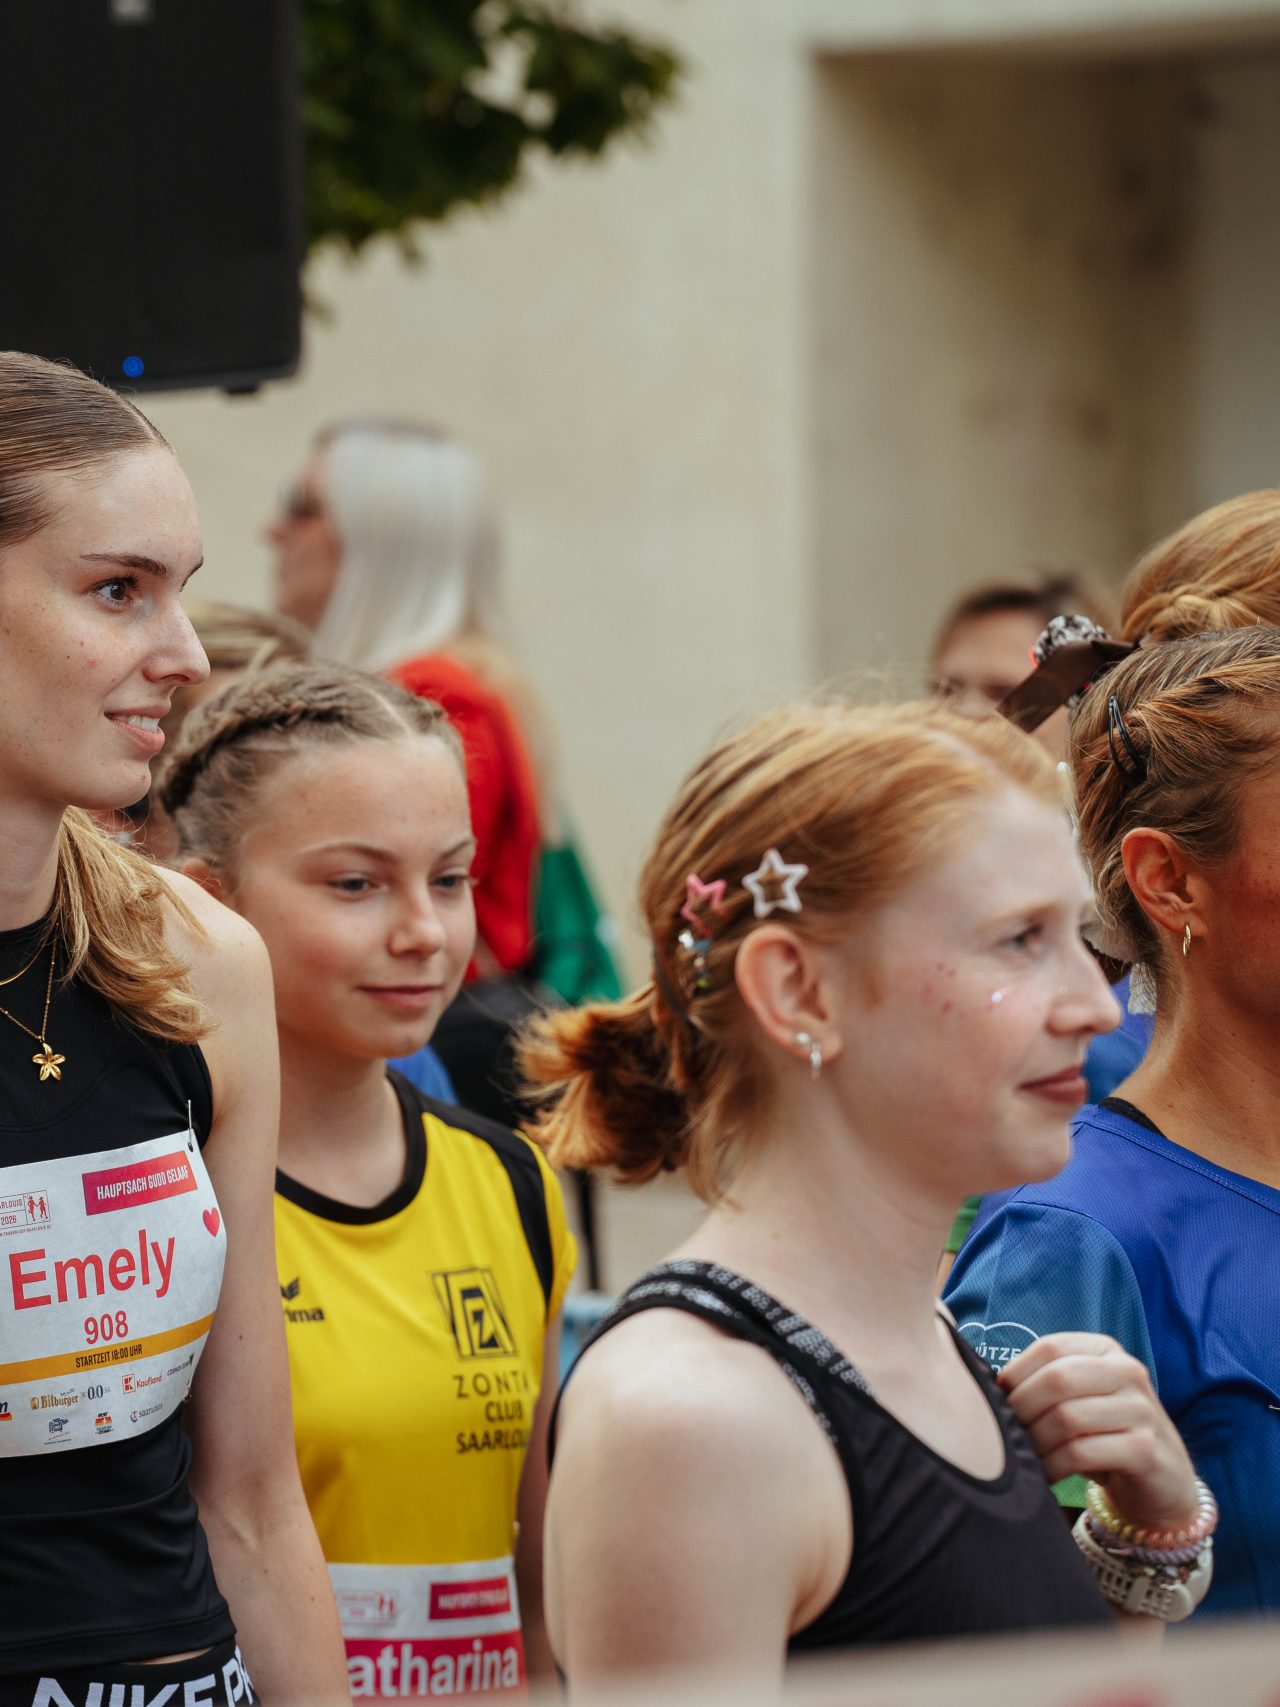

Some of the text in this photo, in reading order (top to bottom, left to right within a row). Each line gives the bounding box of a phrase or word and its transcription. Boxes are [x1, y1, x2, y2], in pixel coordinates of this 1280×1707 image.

[97, 1176, 147, 1200] HAUPTSACH
[148, 1171, 166, 1188] GUDD
[0, 1215, 17, 1225] 2026
[9, 1229, 176, 1310] Emely
[84, 1310, 129, 1345] 908
[75, 1344, 143, 1368] STARTZEIT 18:00 UHR
[975, 1341, 1022, 1361] ÜTZE
[136, 1374, 163, 1388] Kaufland
[40, 1394, 79, 1409] Bitburger
[87, 1384, 104, 1400] 0.0
[484, 1399, 523, 1422] CLUB
[347, 1639, 519, 1697] atharina
